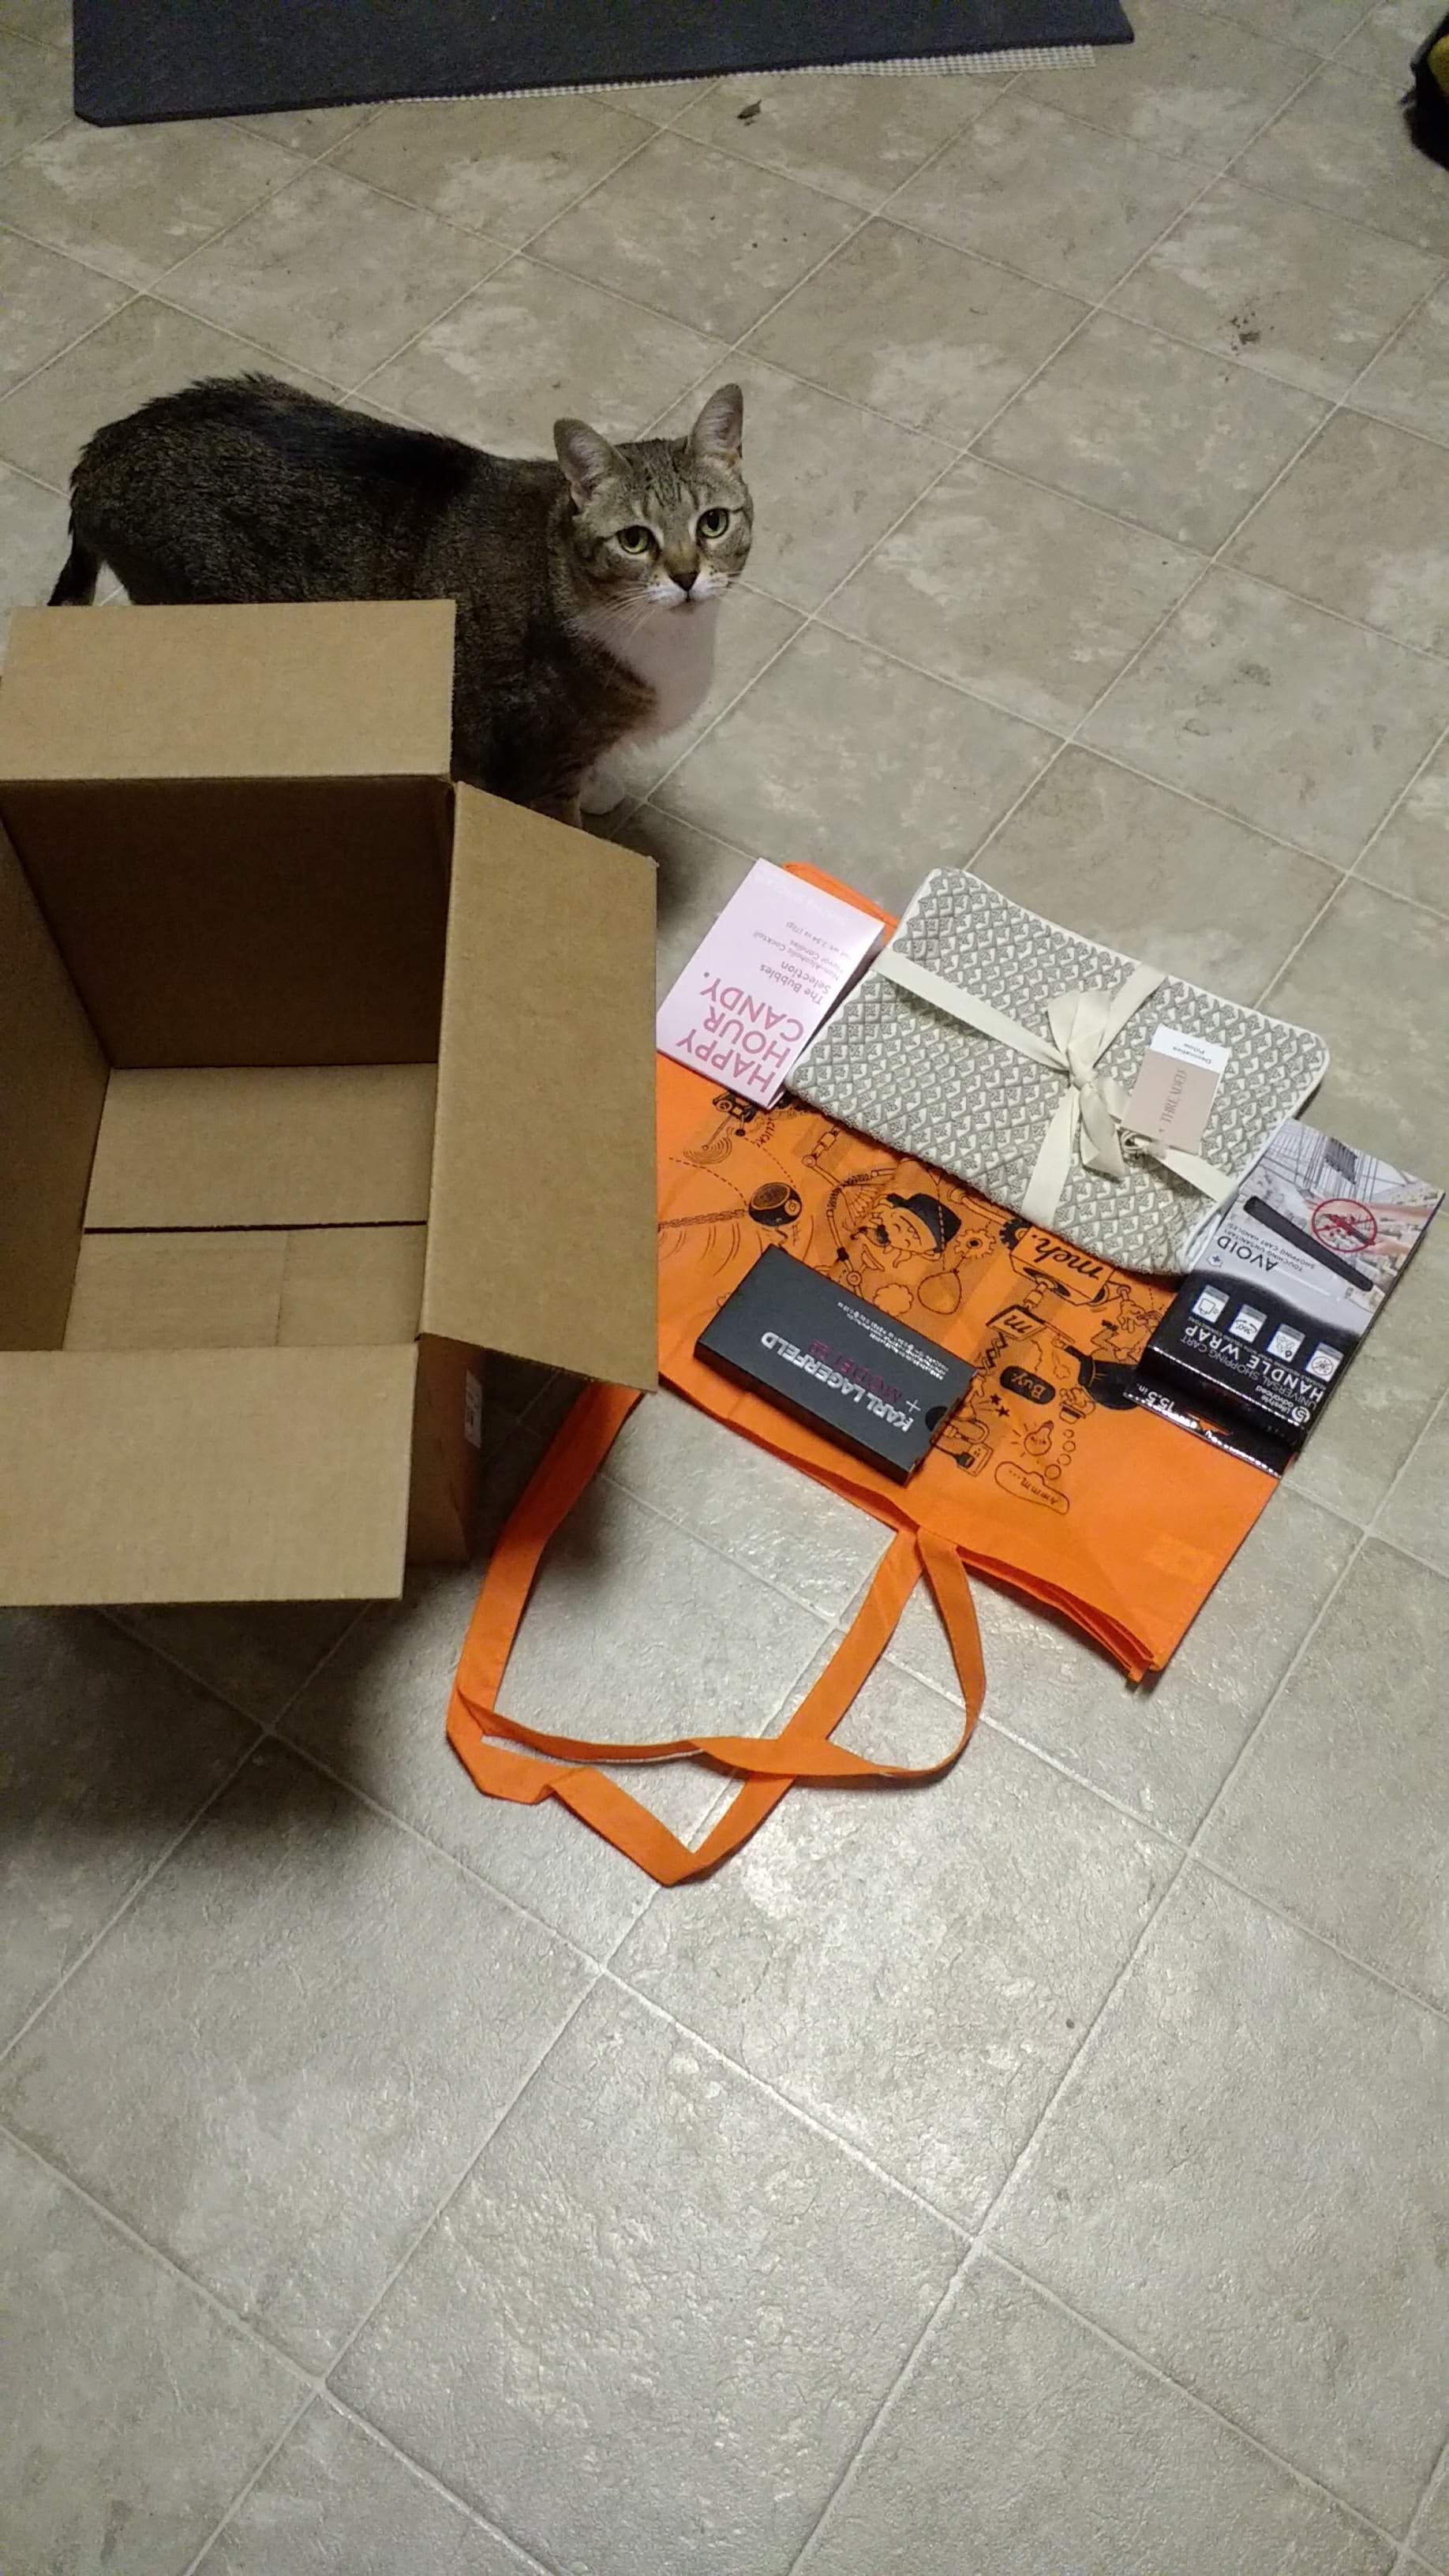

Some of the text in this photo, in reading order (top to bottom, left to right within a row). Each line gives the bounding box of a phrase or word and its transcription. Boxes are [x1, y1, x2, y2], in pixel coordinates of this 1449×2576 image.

[751, 930, 787, 952] Cocktail
[788, 938, 821, 960] Candies
[758, 963, 825, 1005] The Bubbles
[779, 960, 832, 994] Selection
[698, 971, 803, 1041] CANDY.
[702, 1005, 792, 1069] HOUR
[674, 1028, 777, 1093] HAPPY
[1030, 1233, 1104, 1280] meh.
[1216, 1234, 1279, 1271] AVOID
[1222, 1227, 1303, 1271] TOUCHING UNSANITARY
[1260, 1238, 1279, 1251] CART
[1279, 1247, 1315, 1269] SHOPPING
[1002, 1313, 1032, 1335] m
[1184, 1321, 1237, 1360] WRAP
[758, 1328, 867, 1403] LAGERFELD
[1178, 1333, 1316, 1411] UNIVERSAL SHOPPING CART
[1245, 1354, 1324, 1403] HANDLE
[860, 1391, 914, 1432] KARL
[1135, 1382, 1176, 1413] 15.5 in.
[1254, 1383, 1295, 1409] advanced
[1260, 1393, 1291, 1415] Lifestyle
